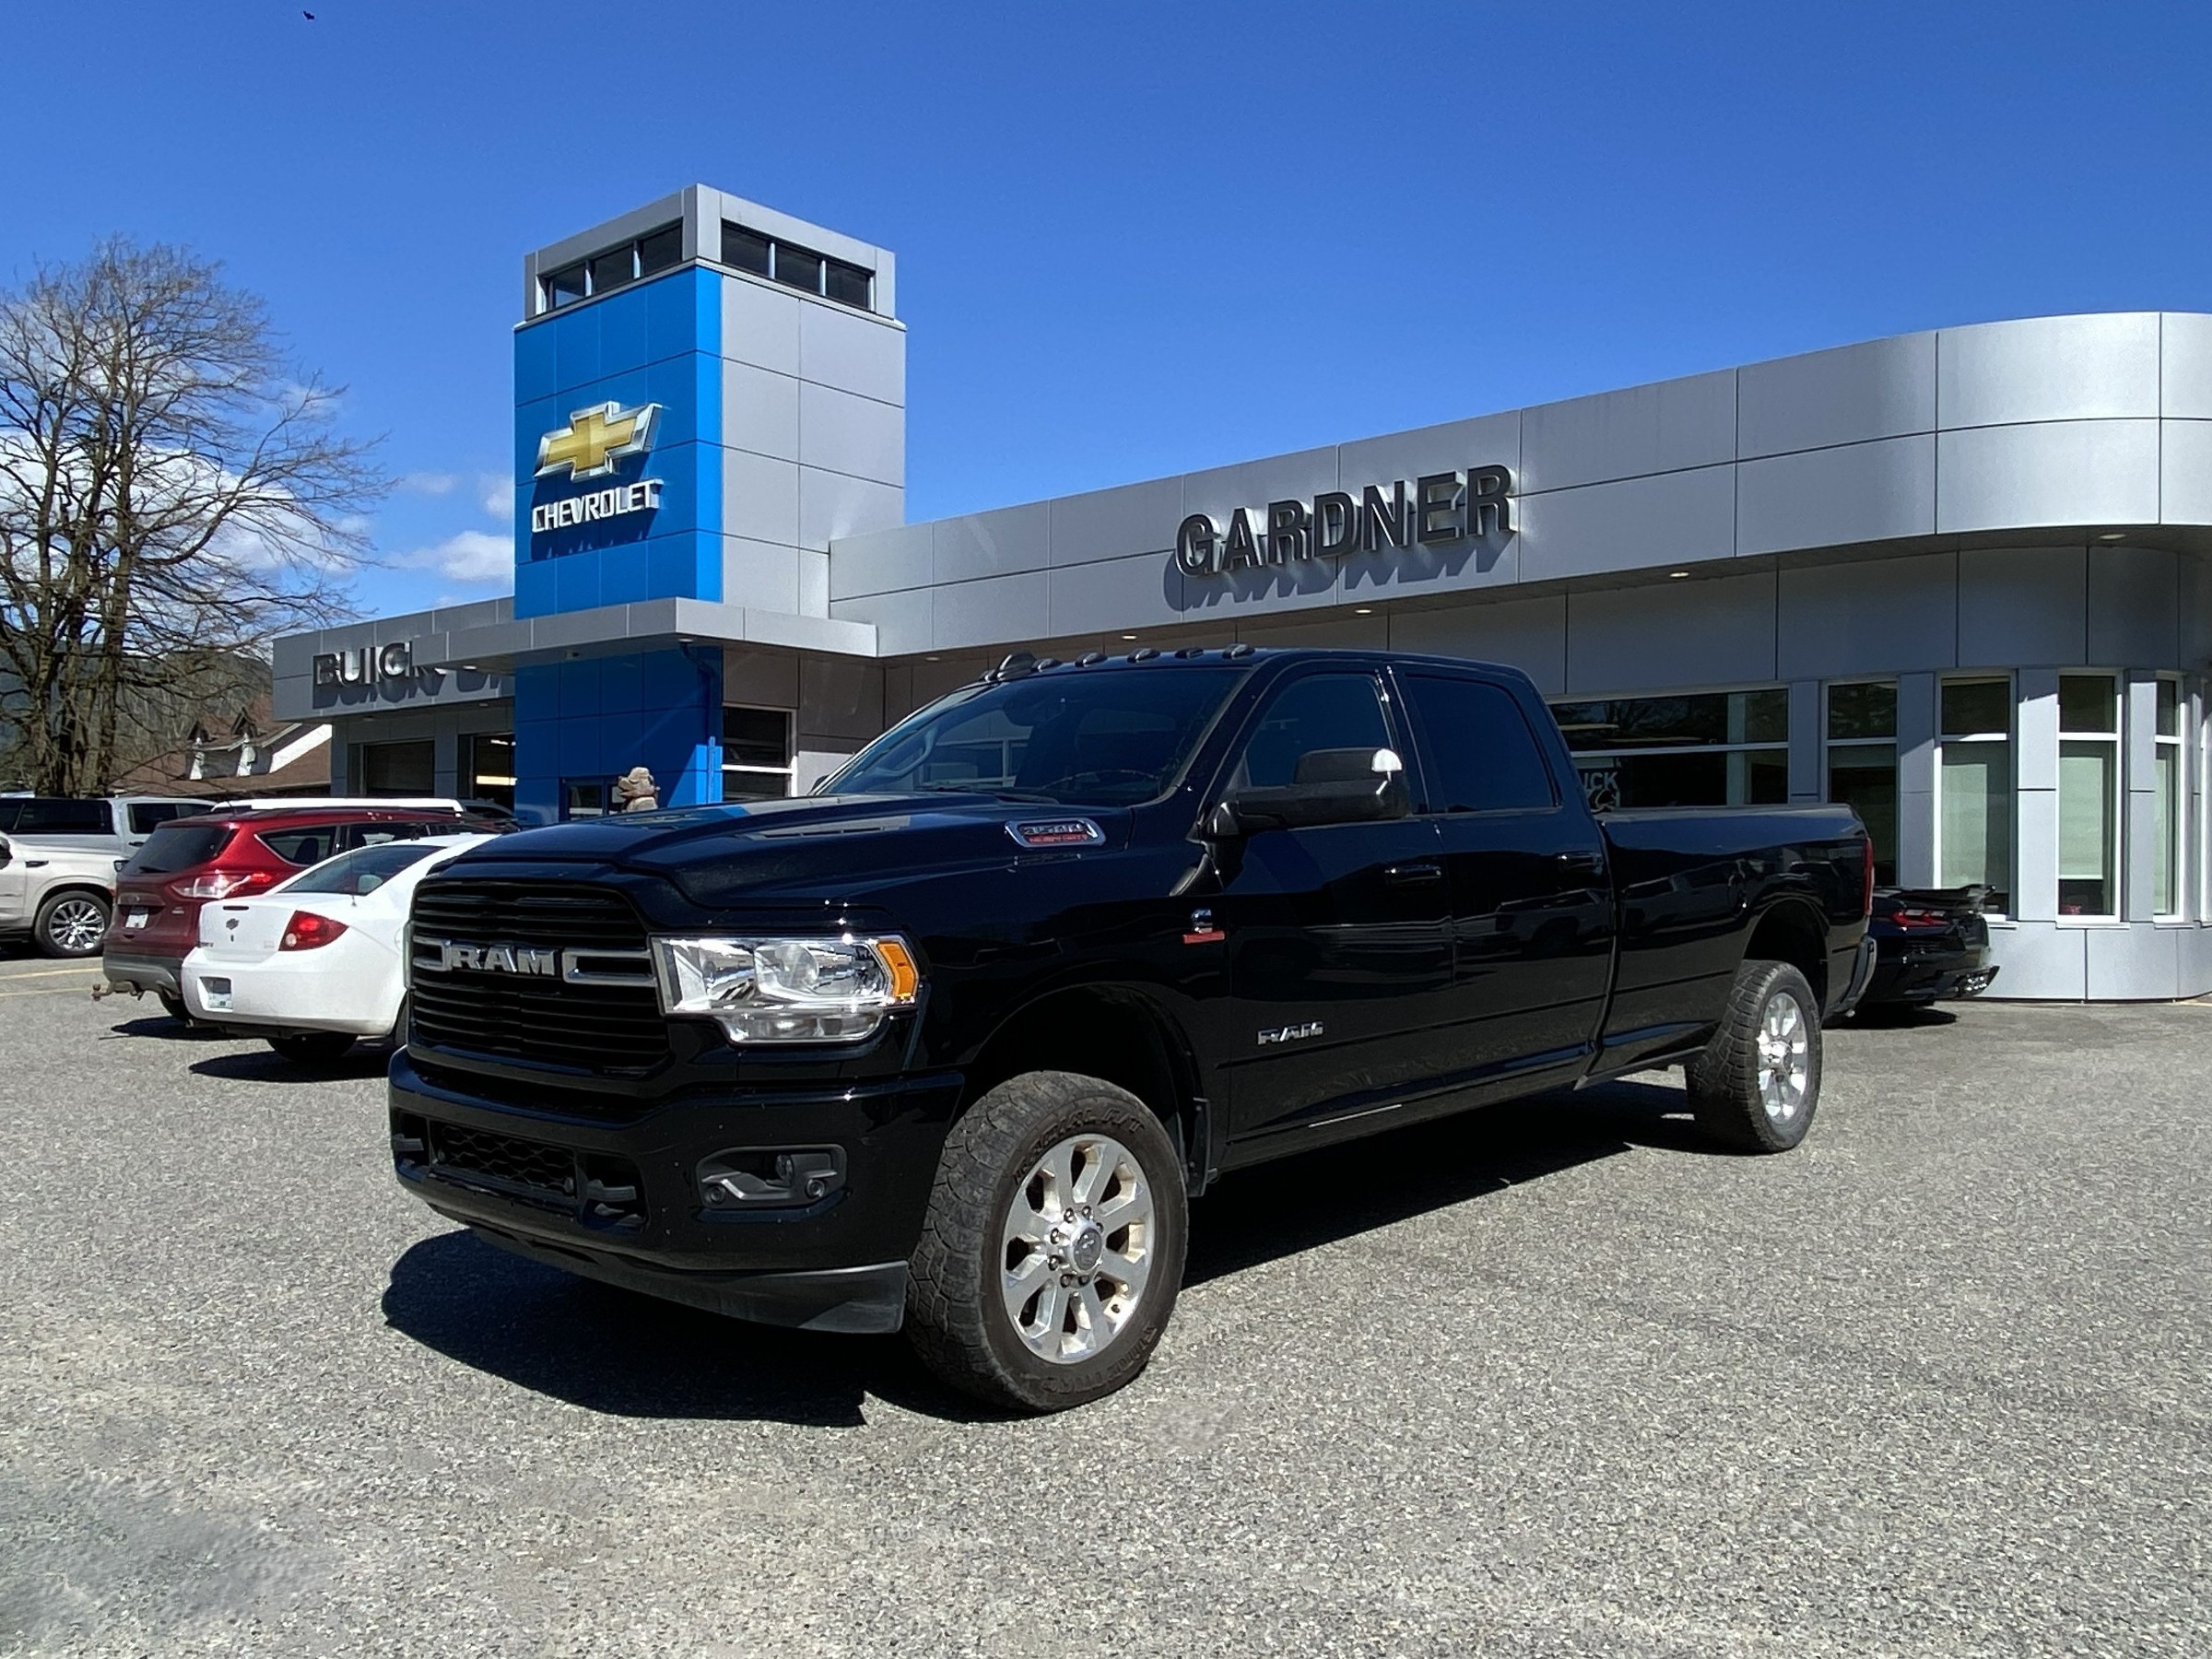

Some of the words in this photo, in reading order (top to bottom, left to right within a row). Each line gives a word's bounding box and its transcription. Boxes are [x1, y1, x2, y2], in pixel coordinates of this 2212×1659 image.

[531, 478, 661, 533] CHEVROLET
[1175, 464, 1516, 577] GARDNER
[450, 943, 556, 975] RAM
[1257, 1020, 1323, 1045] RAM
